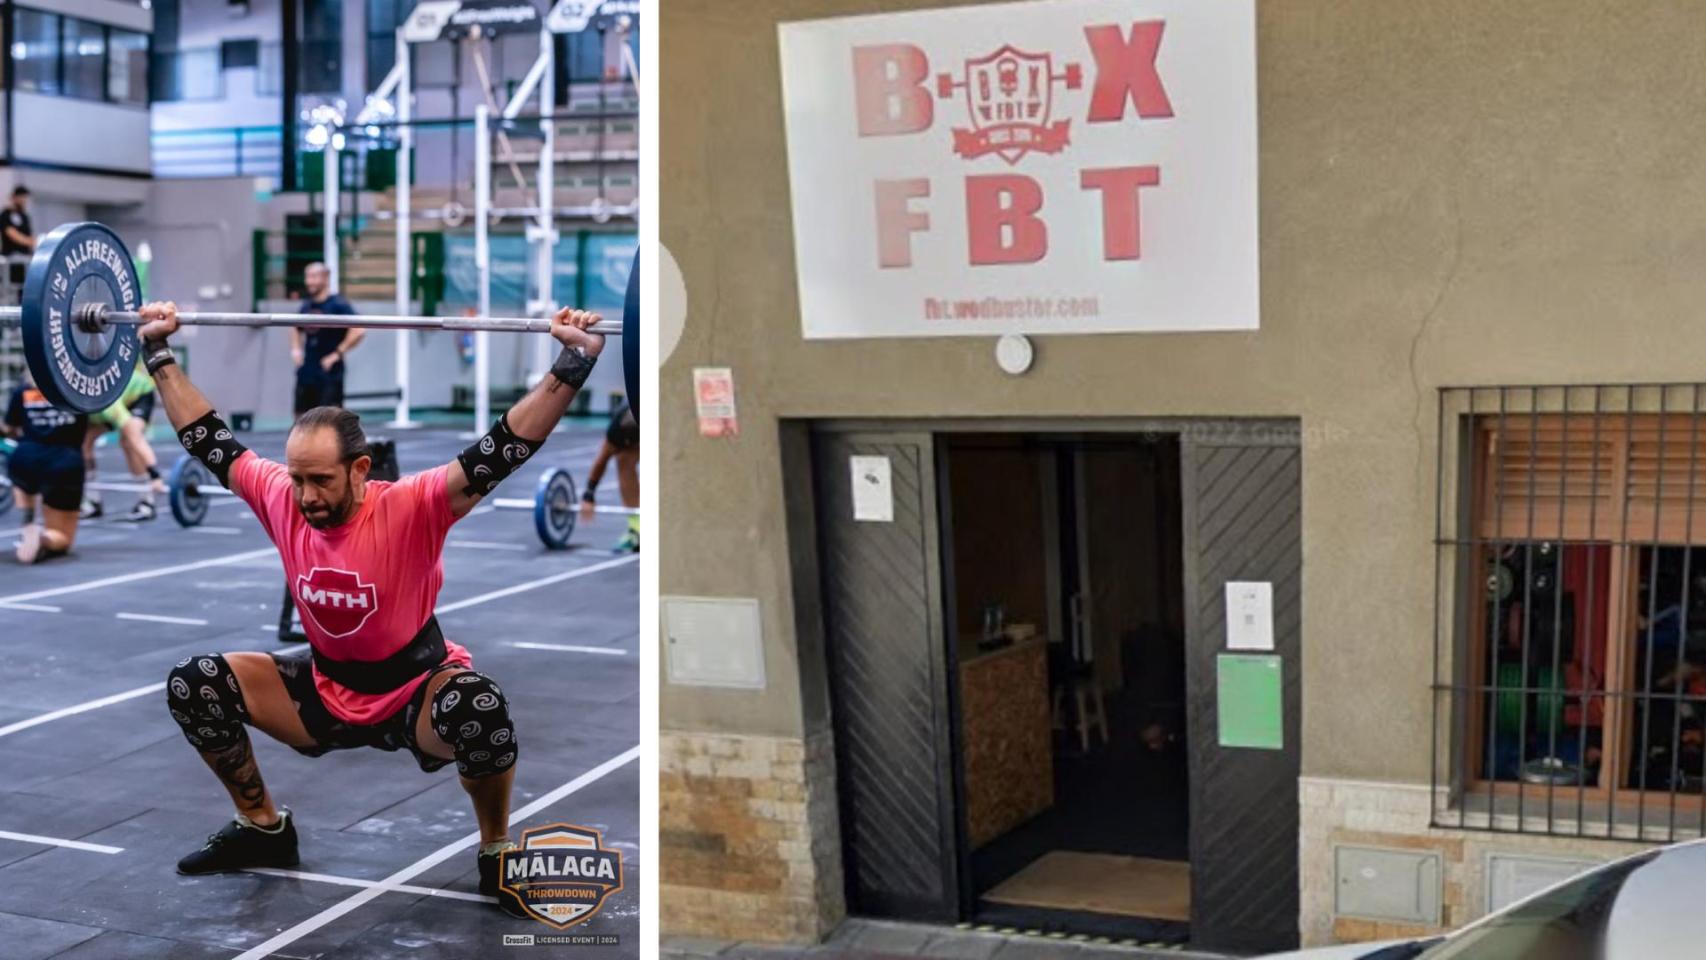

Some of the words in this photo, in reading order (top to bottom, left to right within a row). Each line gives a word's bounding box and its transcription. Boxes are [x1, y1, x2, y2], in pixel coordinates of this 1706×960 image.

[64, 239, 136, 330] ALLFREEWEIGH
[49, 307, 121, 397] ALLFREEWEIGHT
[302, 585, 368, 609] MTH
